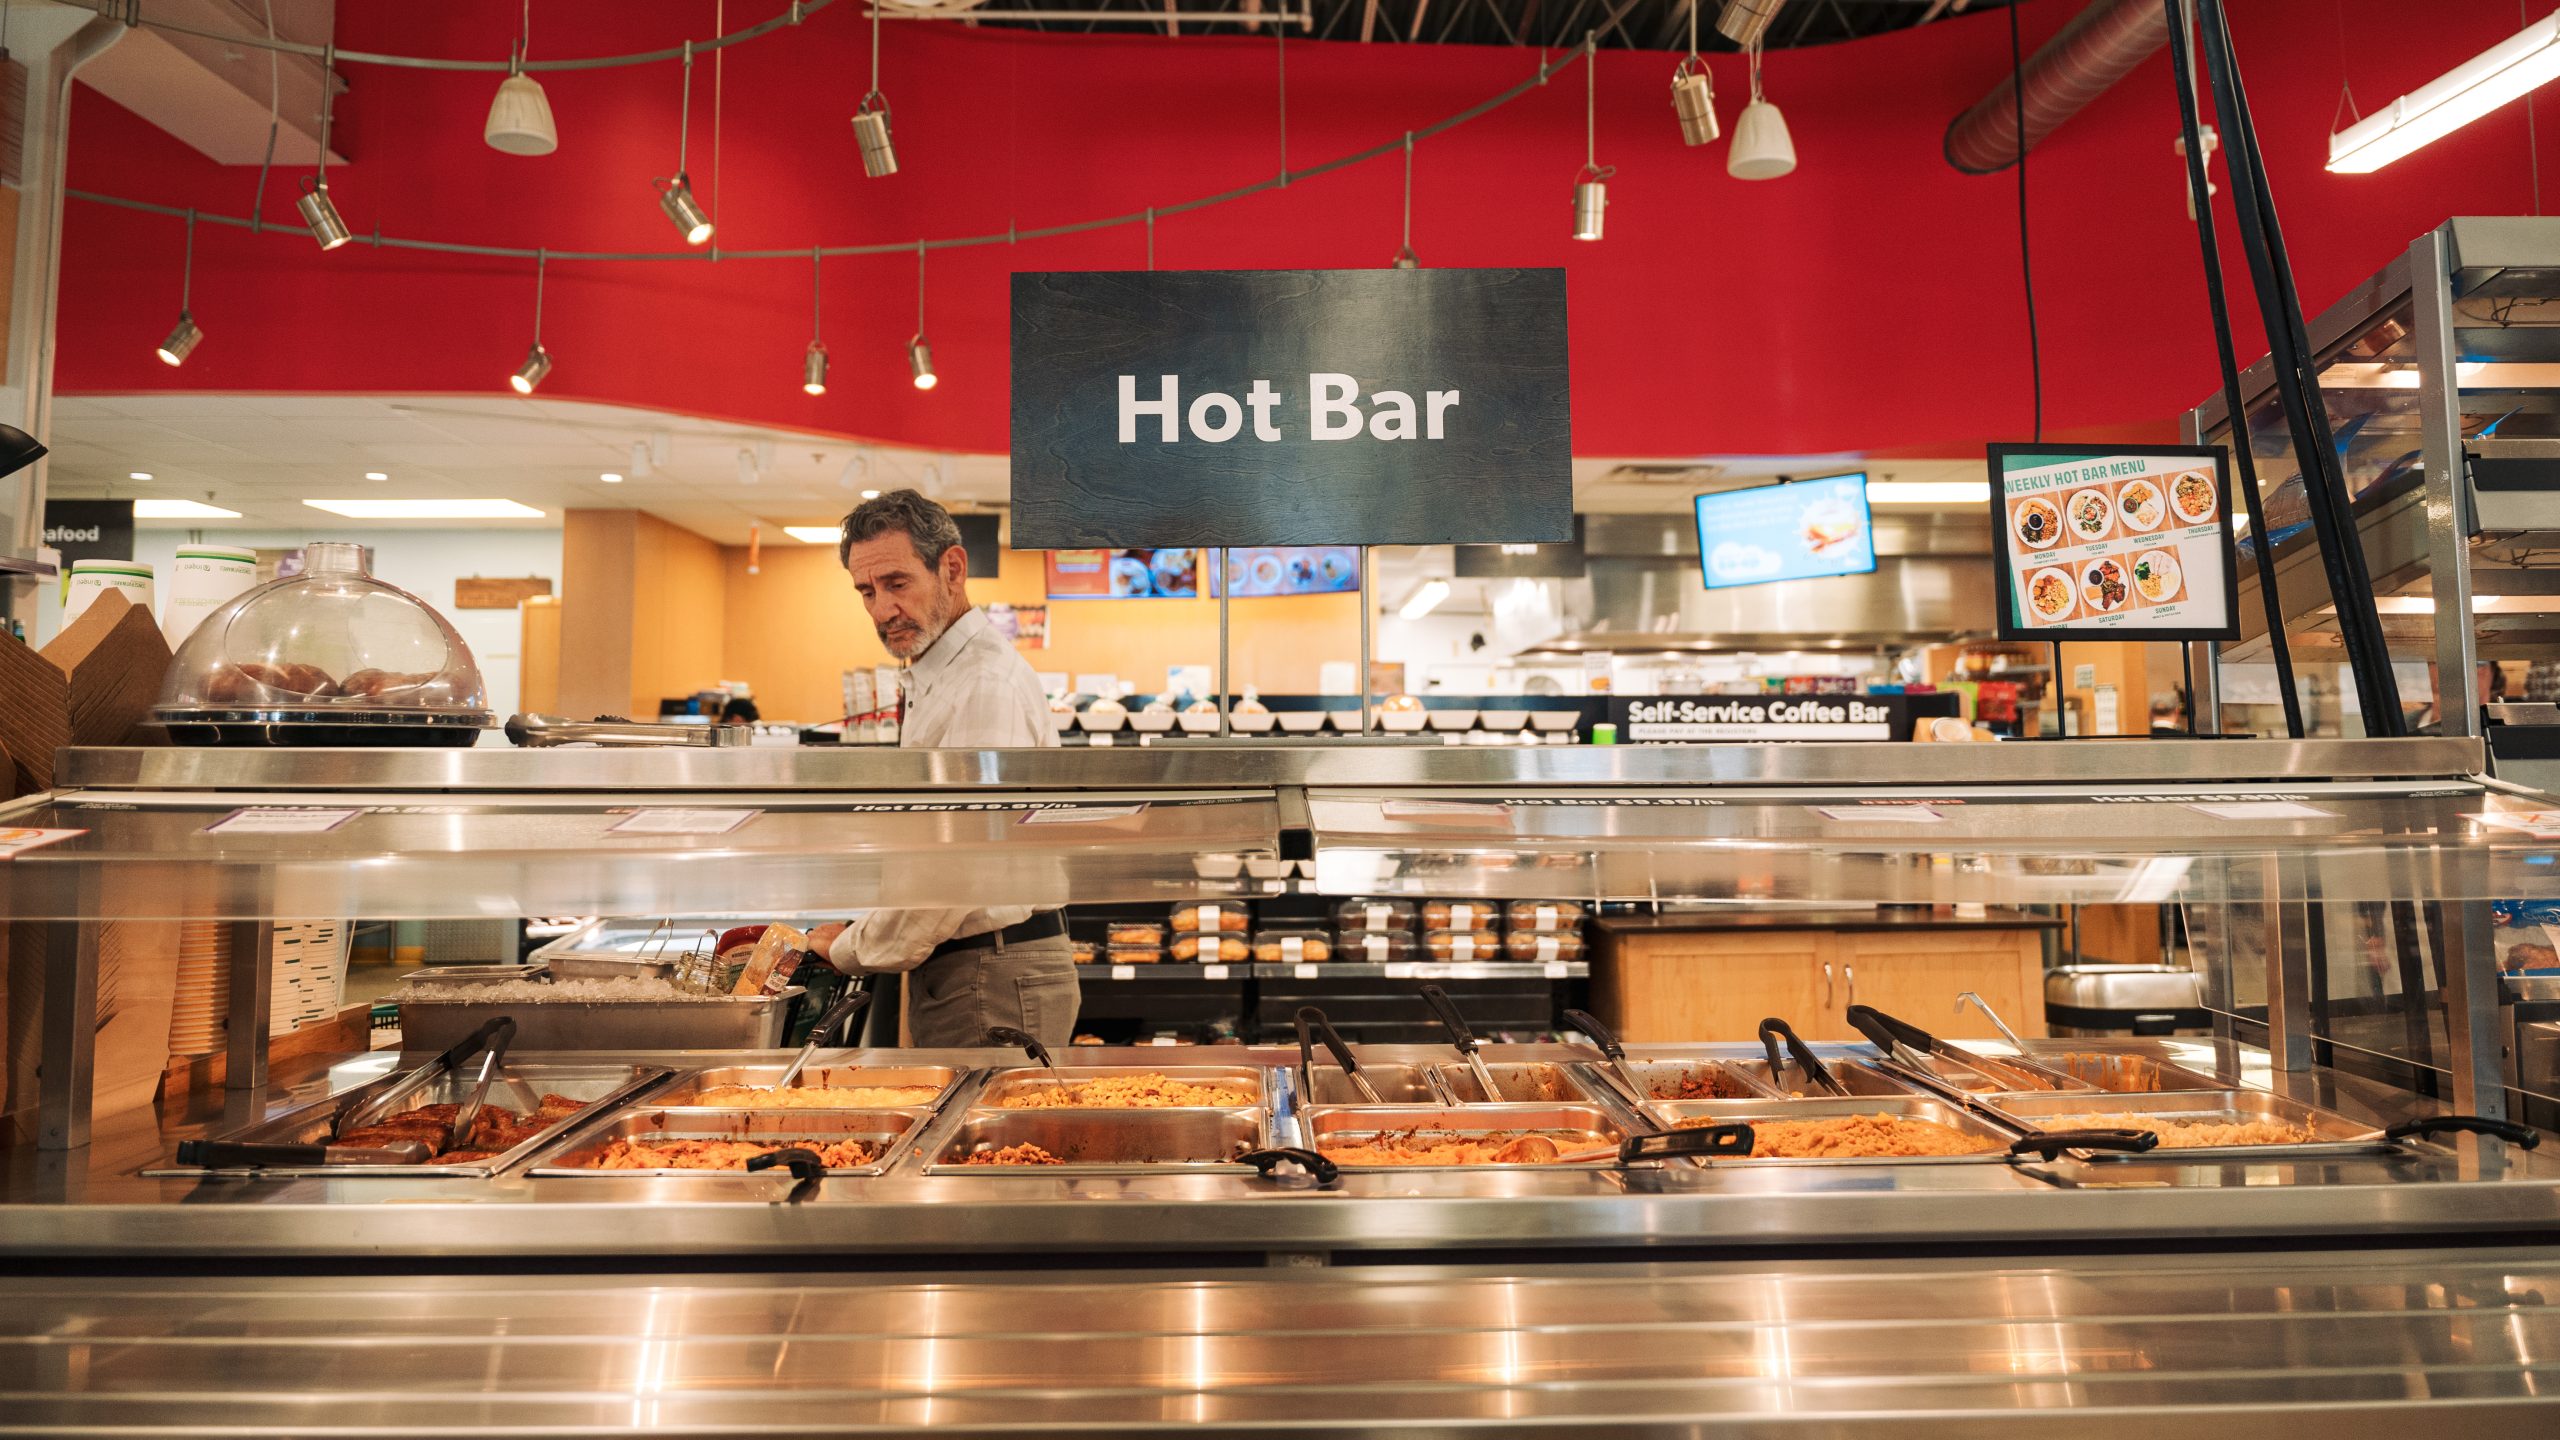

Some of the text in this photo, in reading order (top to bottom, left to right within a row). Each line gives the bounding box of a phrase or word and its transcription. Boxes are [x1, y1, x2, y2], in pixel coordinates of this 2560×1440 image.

[1118, 373, 1460, 443] Hot Bar
[2004, 459, 2146, 494] WEEKLY HOT BAR MENU
[2187, 525, 2214, 535] THURSDAY
[2133, 534, 2165, 544] WEDNESDAY
[2085, 543, 2108, 552] TUESDAY
[2034, 551, 2056, 560] MONDAY
[2155, 605, 2176, 614] SUNDAY
[2098, 613, 2125, 623] SATURDAY
[1629, 701, 1889, 723] Self-Service Coffee Bar
[966, 802, 1077, 810] $9.99/lb
